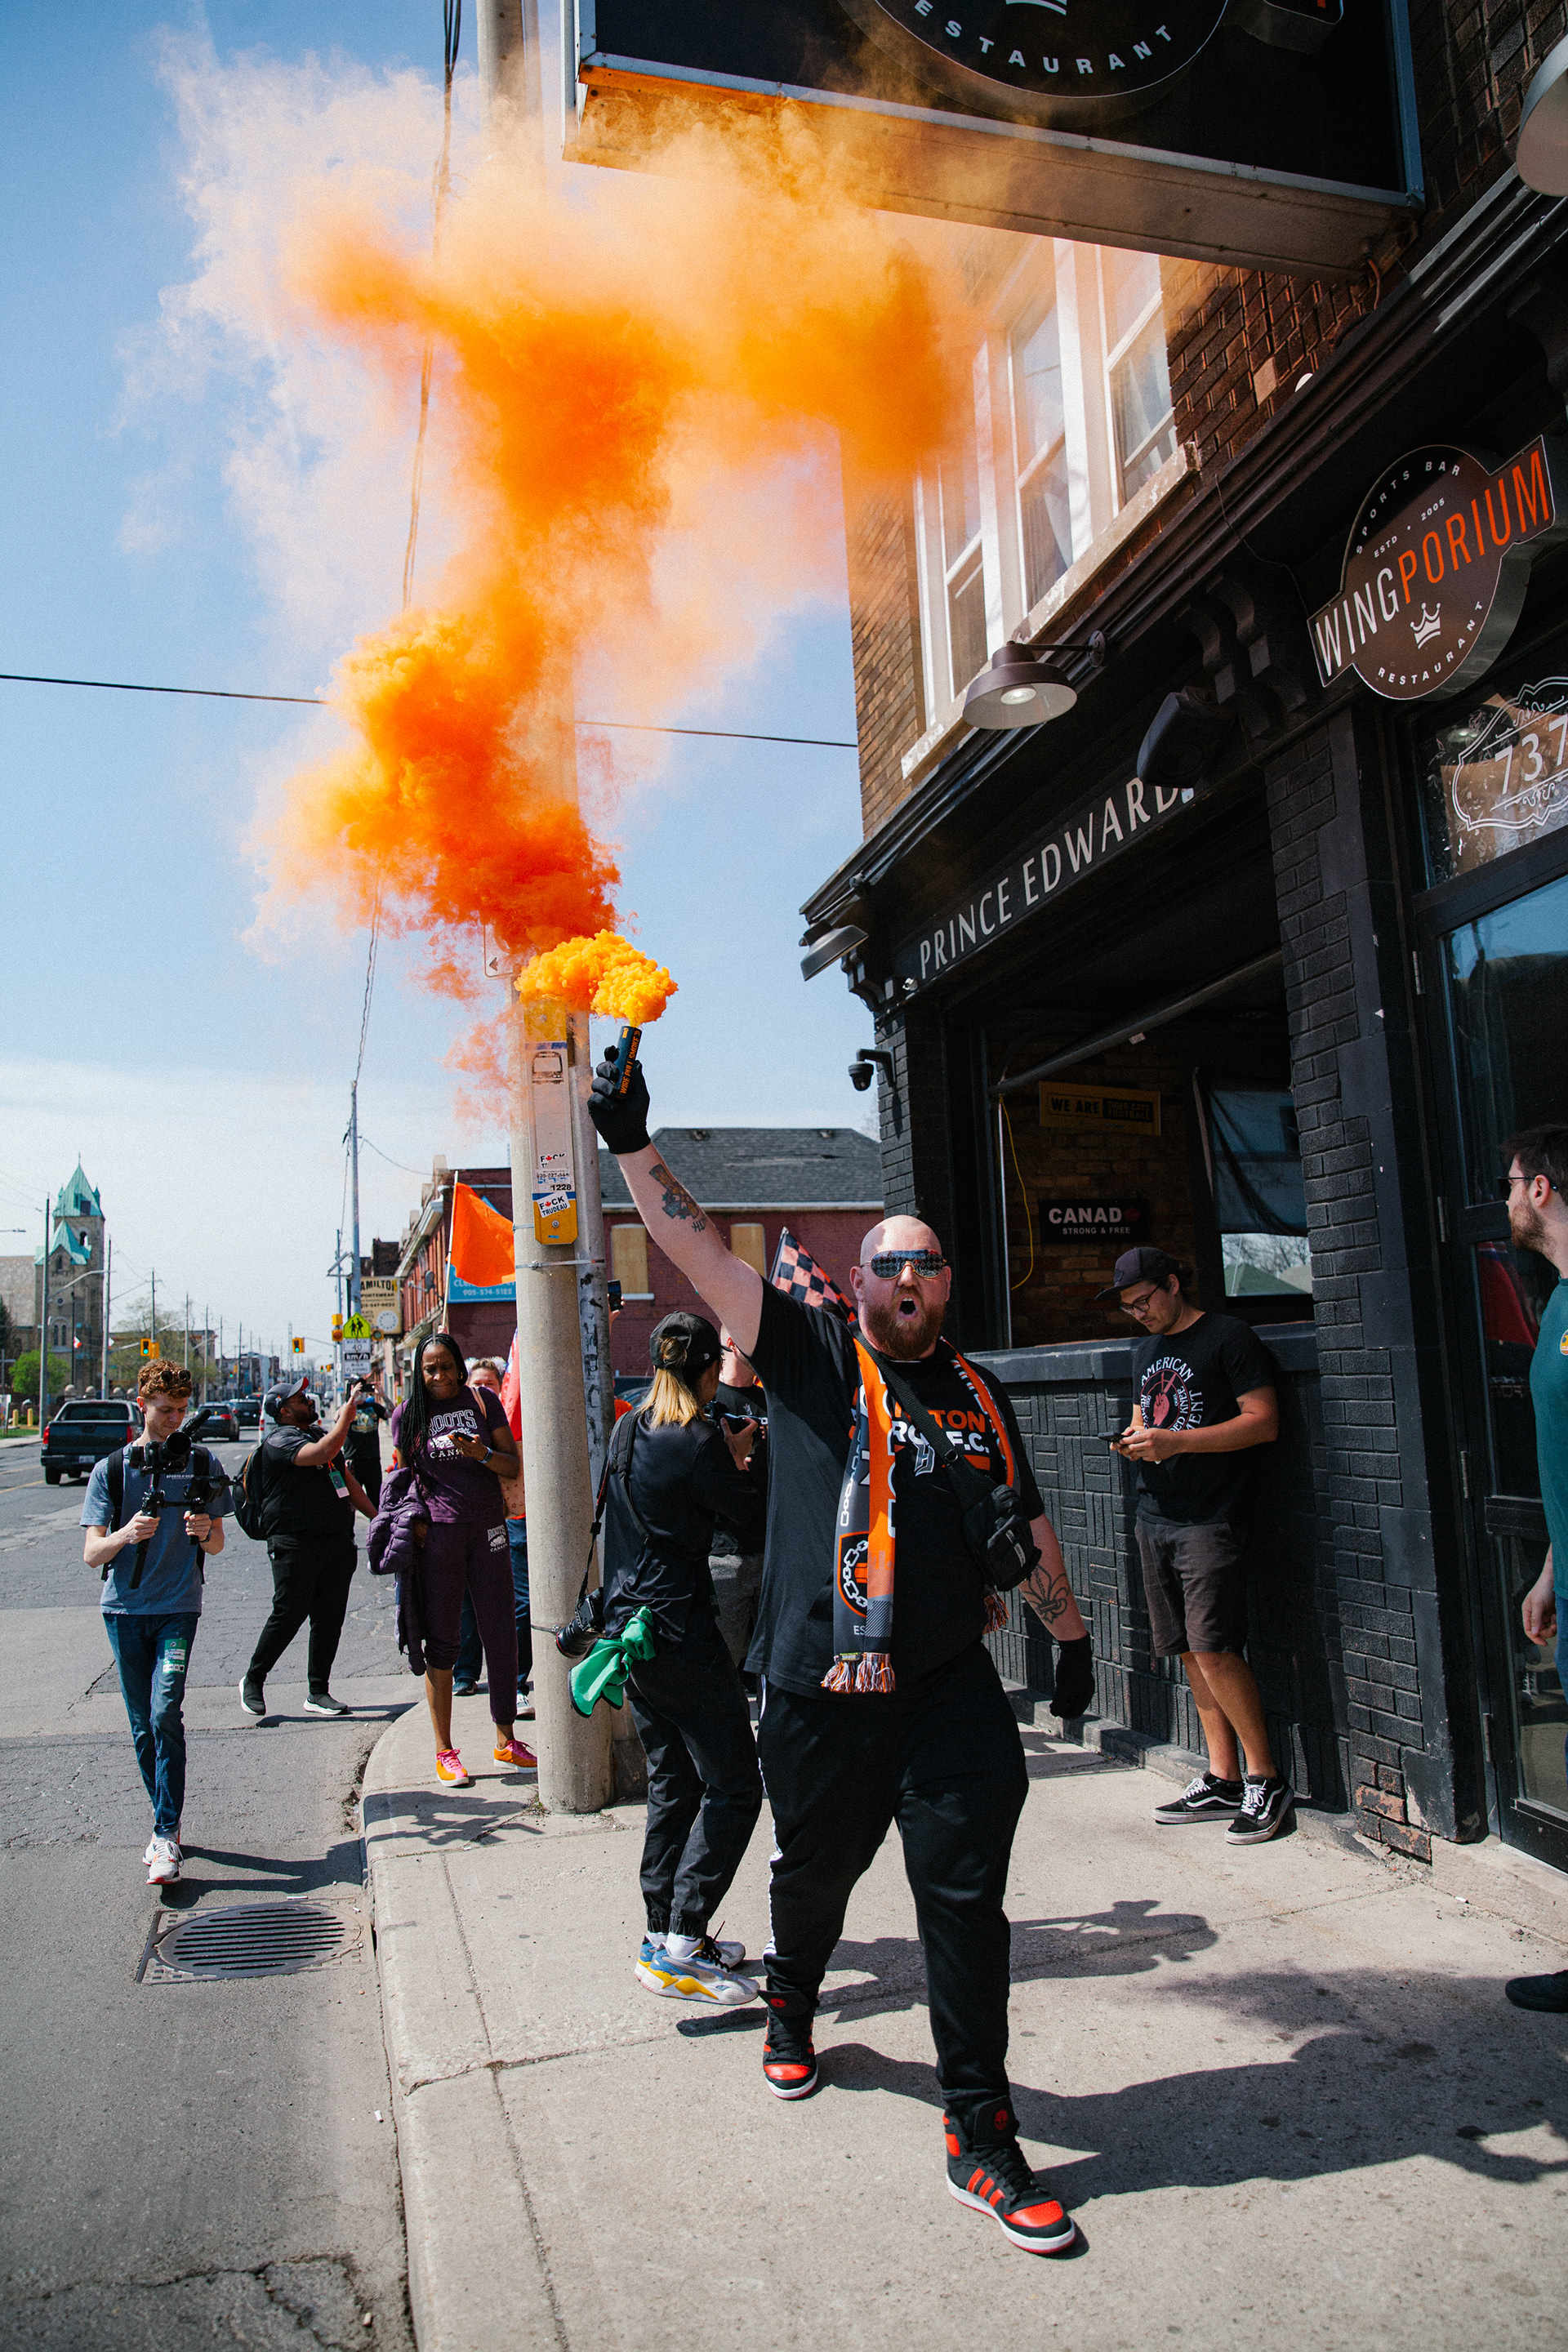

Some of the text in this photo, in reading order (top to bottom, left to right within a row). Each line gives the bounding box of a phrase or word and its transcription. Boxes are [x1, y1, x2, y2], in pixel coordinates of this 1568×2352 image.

[1356, 461, 1461, 555] SPORTS BAR
[1373, 498, 1446, 559] ESTD 2005
[1378, 600, 1484, 684] RESTAURANT
[1494, 715, 1568, 795] 737
[920, 877, 1012, 980] PRINCE
[629, 1036, 640, 1059] SMOKE
[1050, 1098, 1100, 1115] WE ARE
[550, 1183, 572, 1192] 1228
[541, 1203, 568, 1217] TRUDEAU
[1141, 1356, 1194, 1387] AMERICAN
[1178, 1385, 1189, 1414] KNEE
